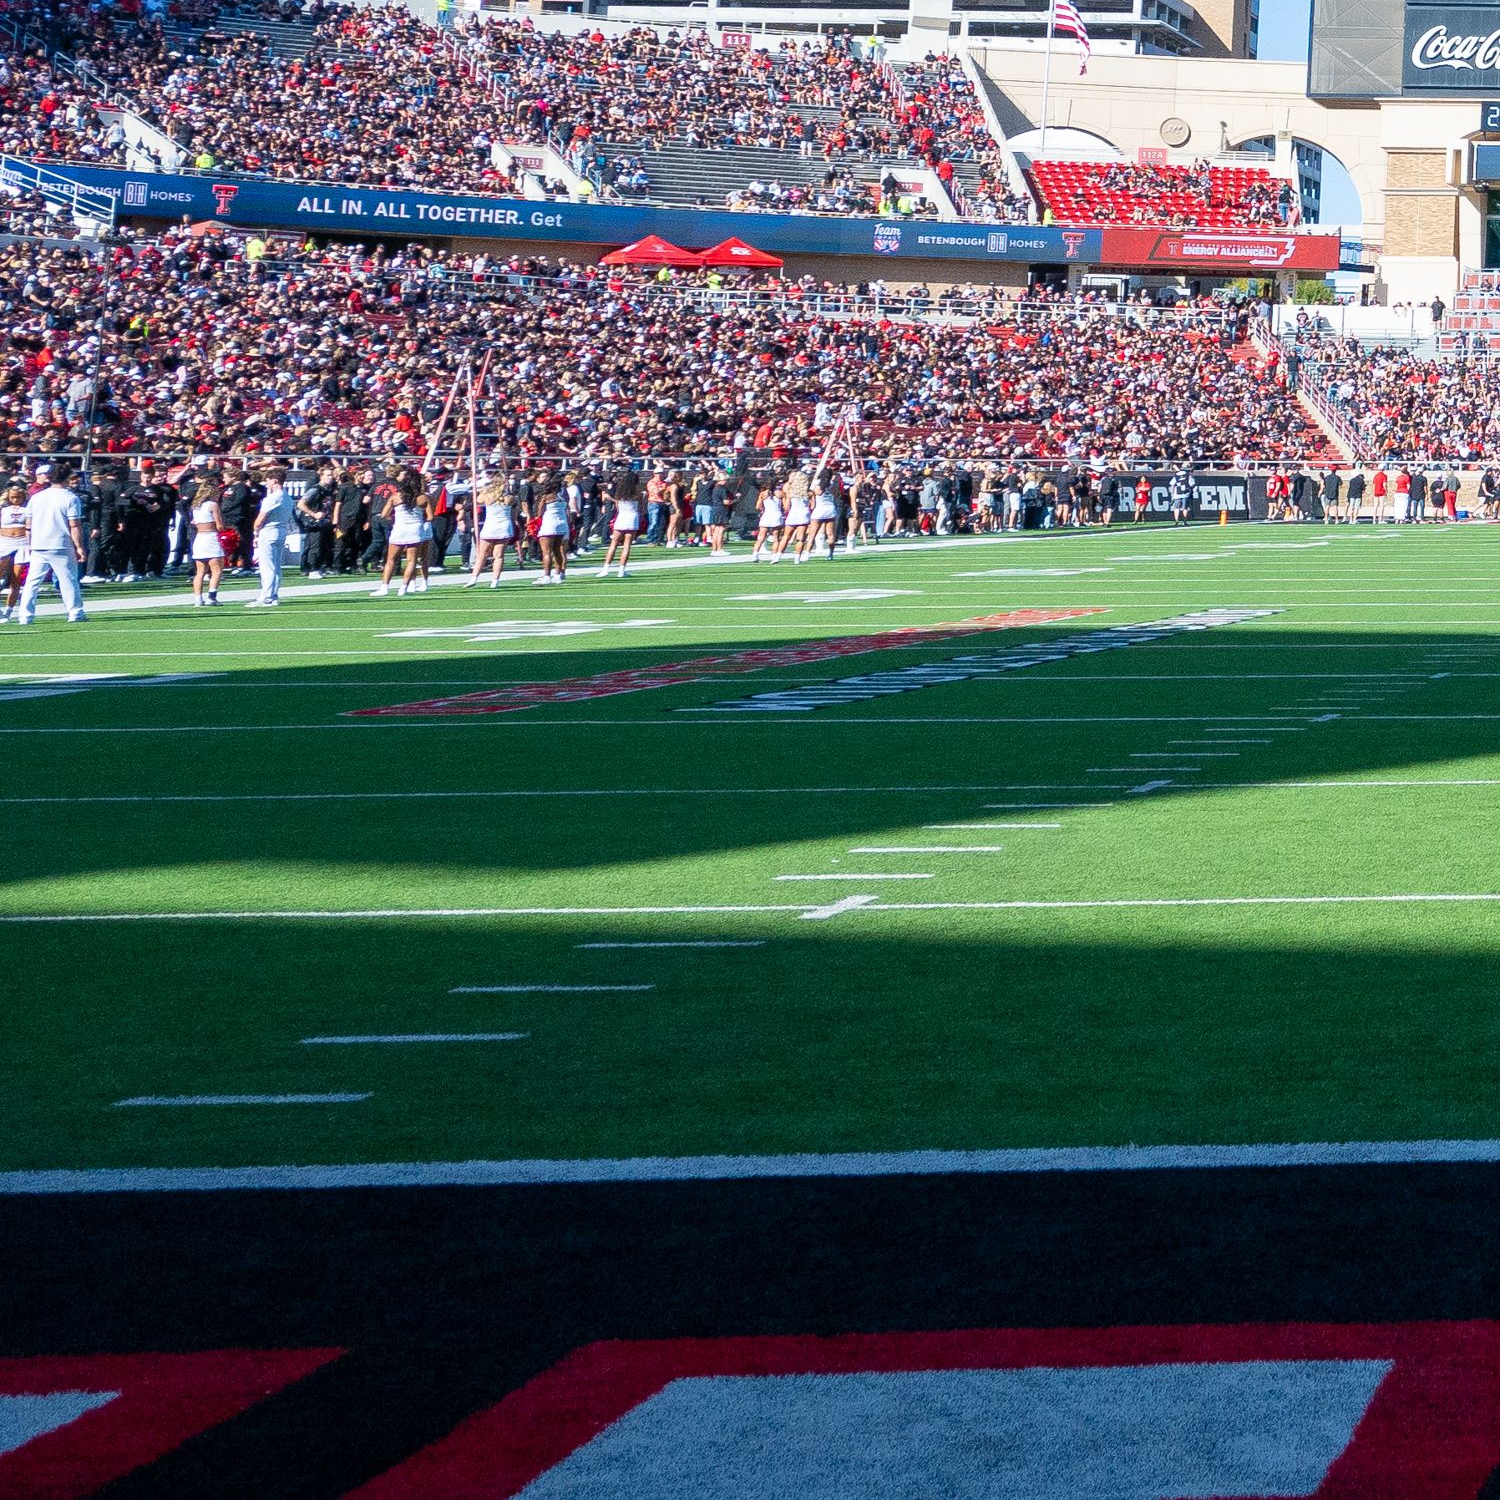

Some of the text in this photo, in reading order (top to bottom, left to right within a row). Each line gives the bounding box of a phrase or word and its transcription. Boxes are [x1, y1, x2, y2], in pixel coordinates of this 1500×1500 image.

[297, 197, 563, 227] ALL IN. ALL TOGETHER. Get
[917, 236, 985, 247] BETENBOUGH
